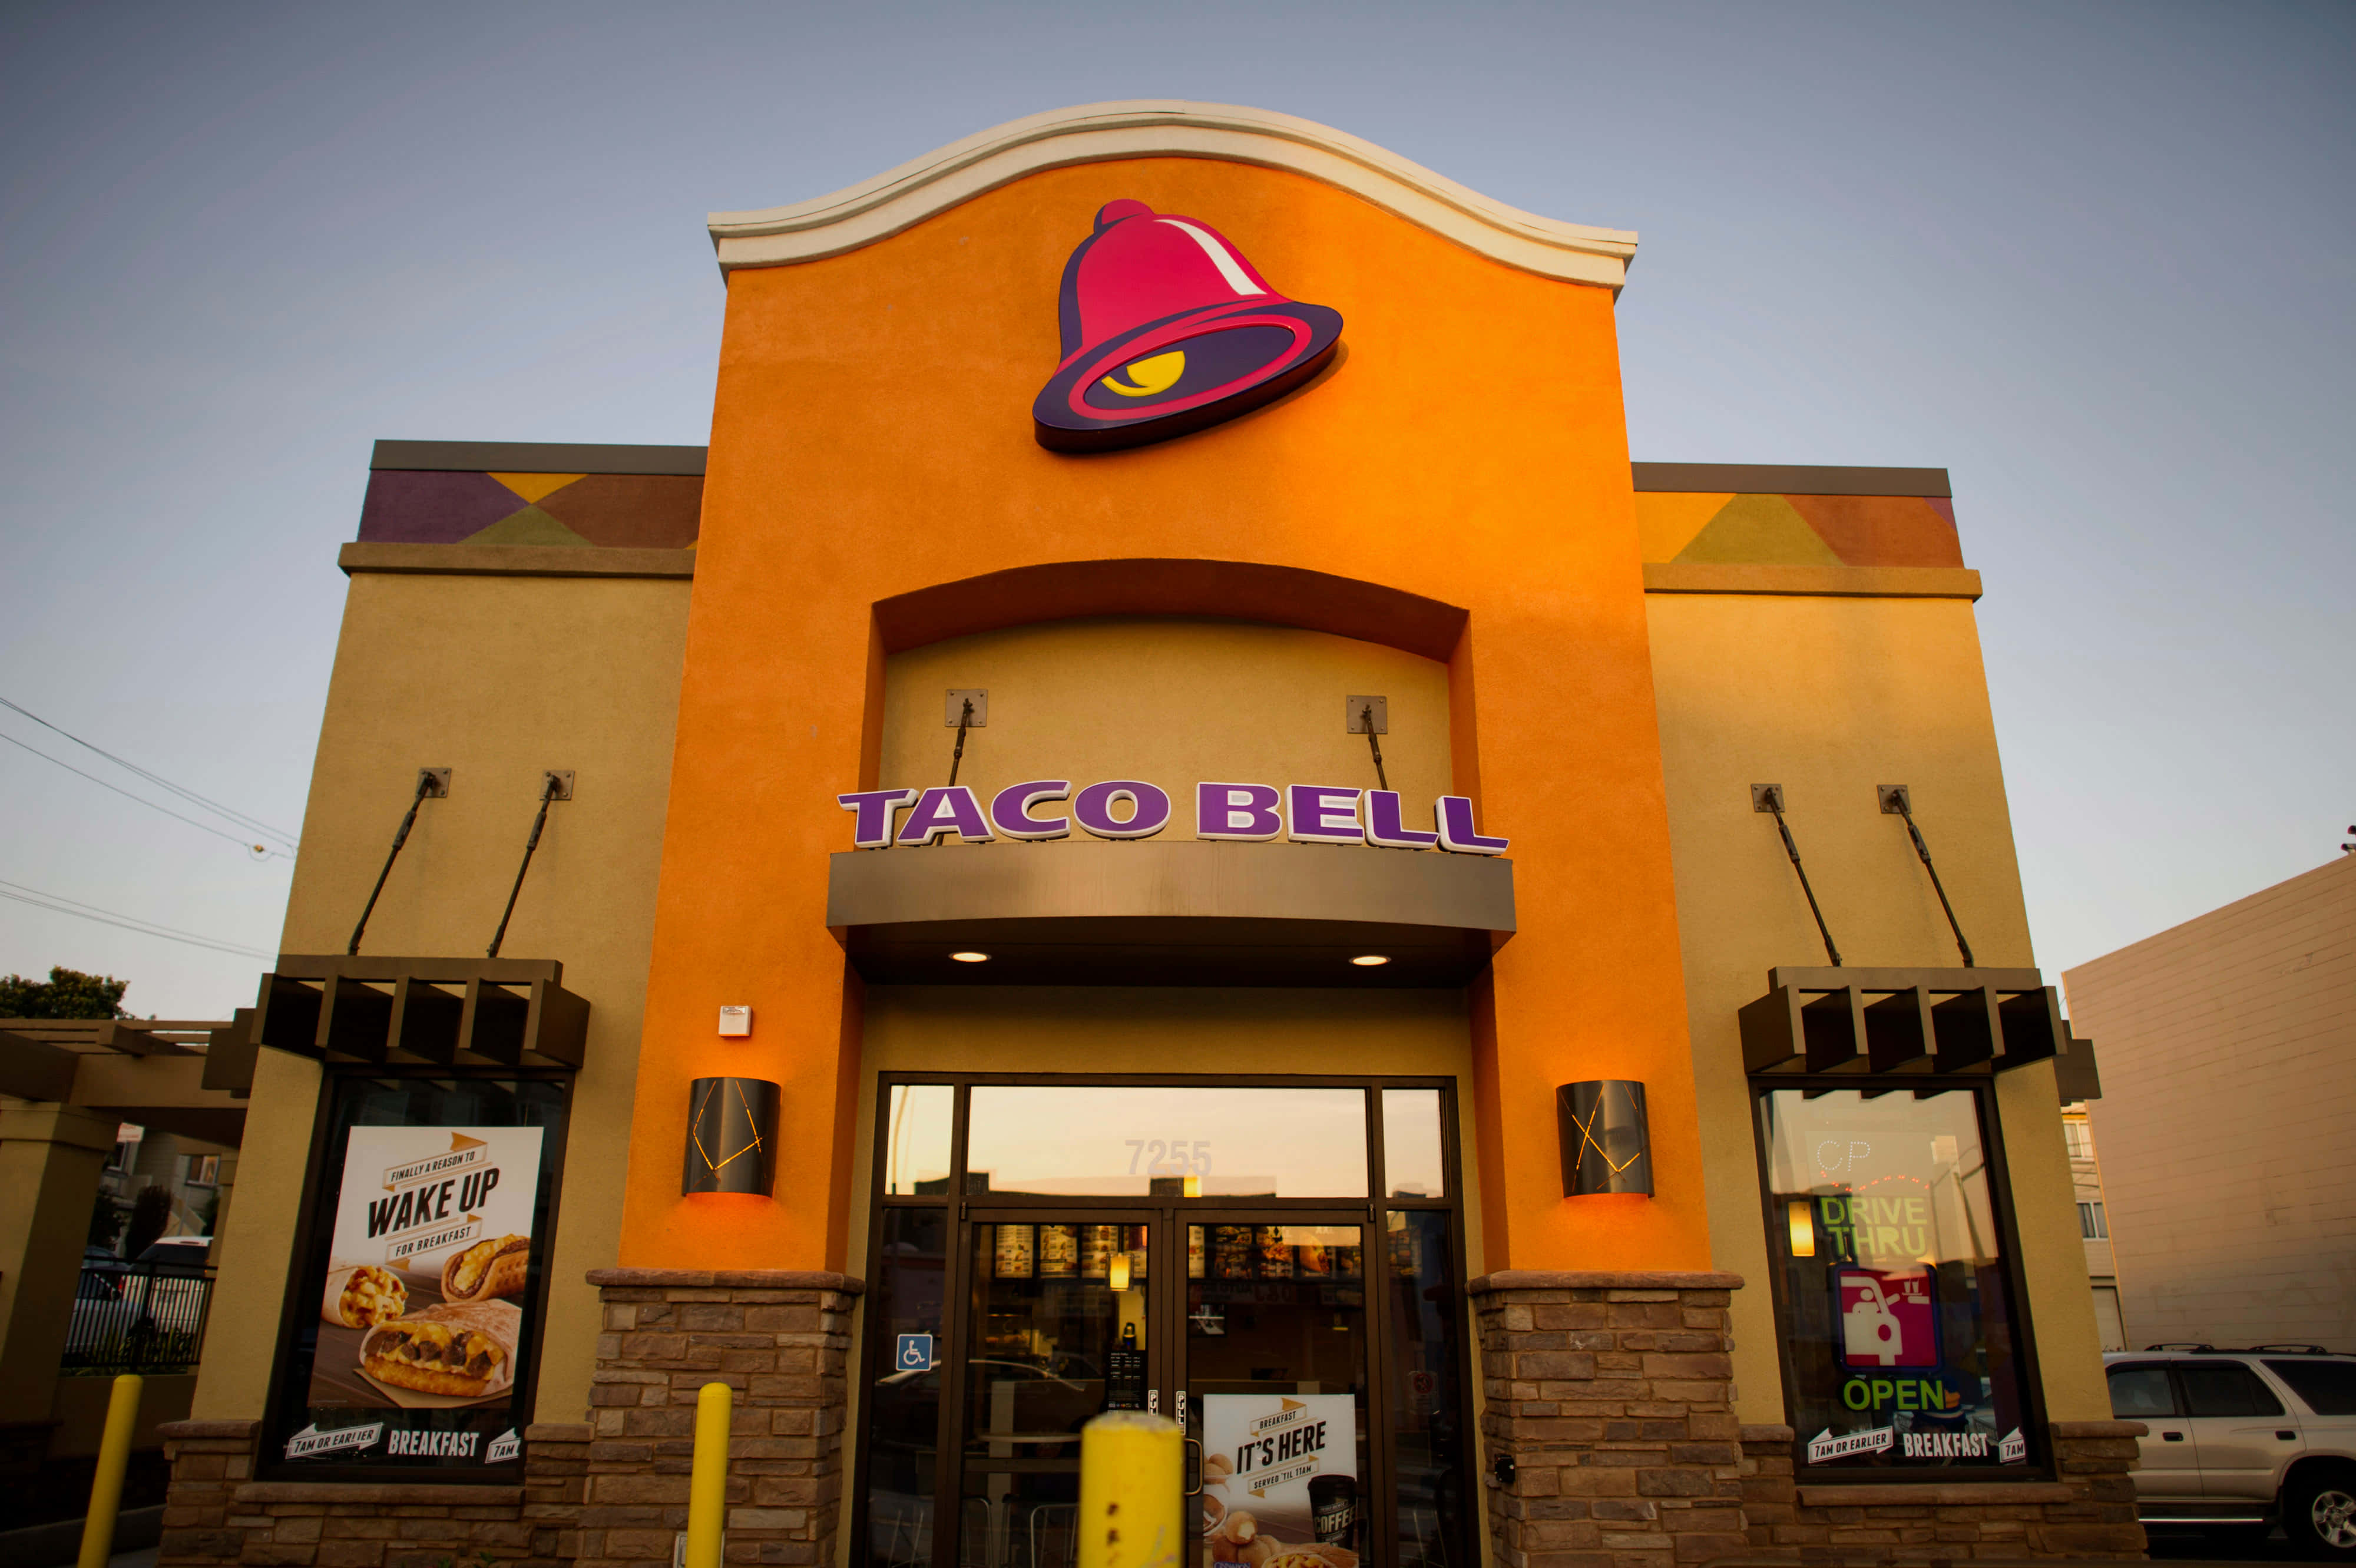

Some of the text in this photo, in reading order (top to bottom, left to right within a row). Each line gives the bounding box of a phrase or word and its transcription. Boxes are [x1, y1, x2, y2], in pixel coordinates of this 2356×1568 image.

[837, 780, 1510, 855] TACO BELL
[391, 1151, 475, 1182] FINALLY A REASON TO
[1125, 1139, 1212, 1176] 7255
[368, 1167, 500, 1239] WAKE UP
[1821, 1197, 1927, 1225] DRIVE
[395, 1226, 471, 1256] FOR BREAKFAST
[1828, 1226, 1925, 1255] THRU
[1844, 1380, 1944, 1410] OPEN
[1259, 1411, 1296, 1430] BREAKFAST
[295, 1439, 315, 1454] 7AM
[317, 1436, 330, 1448] OR
[388, 1430, 479, 1457] BREAKFAST
[494, 1444, 514, 1458] 7AM
[1237, 1421, 1326, 1474] IT'S HERE
[1815, 1434, 1887, 1457] 7AM OR EARLIER
[1903, 1433, 1988, 1457] BREAKFAST
[2006, 1444, 2023, 1456] 7AM
[1254, 1475, 1279, 1489] SERVED
[1296, 1465, 1311, 1476] 11AM
